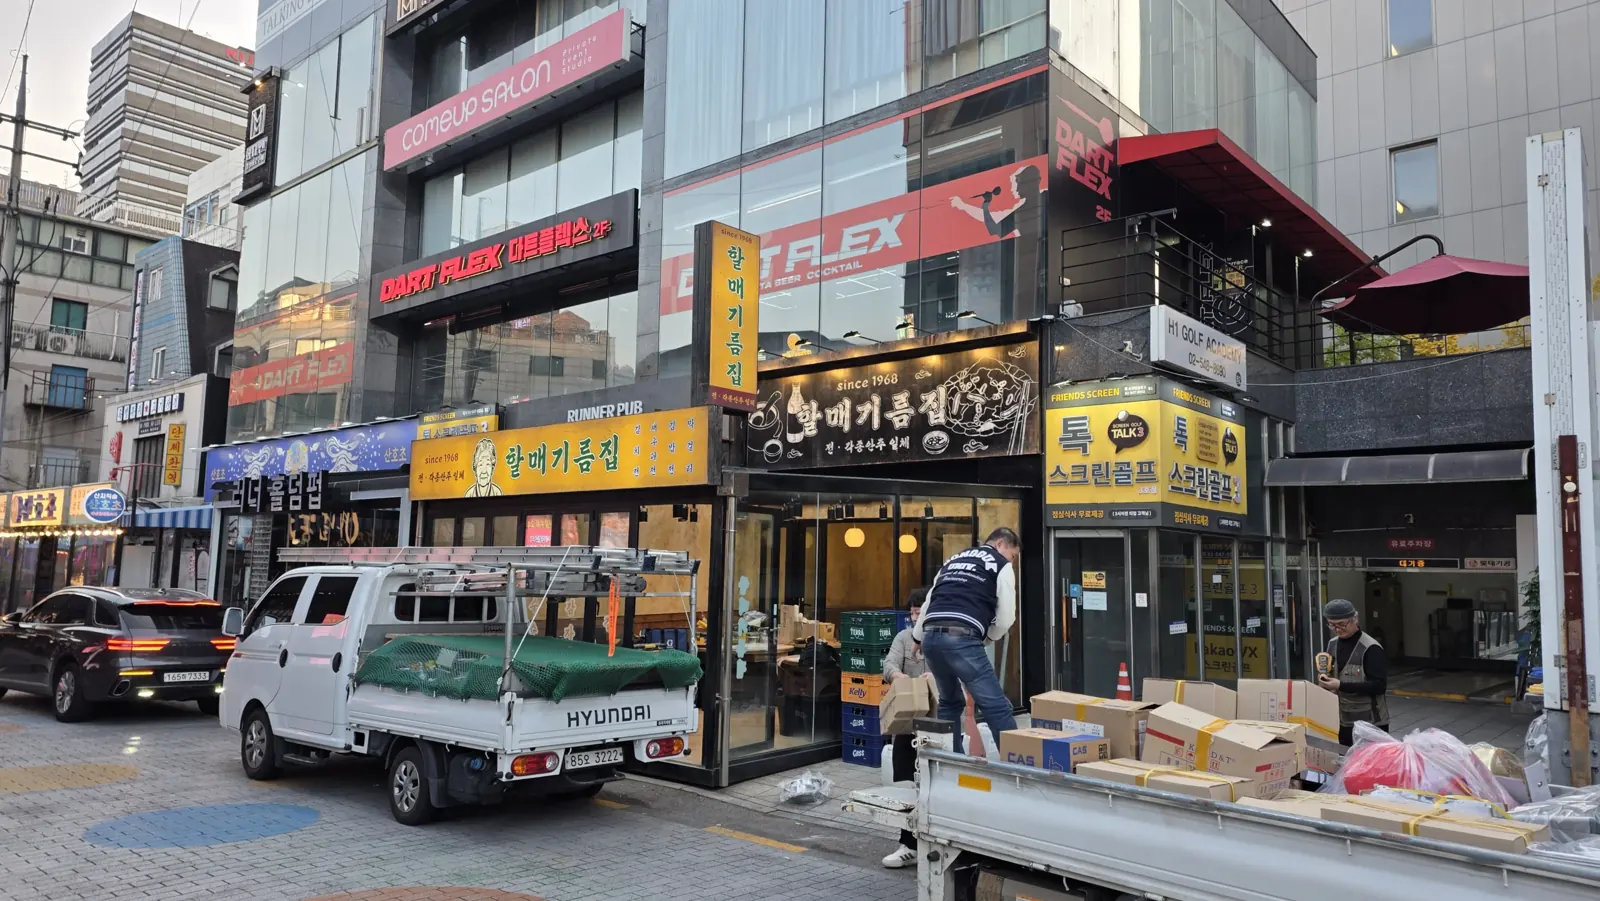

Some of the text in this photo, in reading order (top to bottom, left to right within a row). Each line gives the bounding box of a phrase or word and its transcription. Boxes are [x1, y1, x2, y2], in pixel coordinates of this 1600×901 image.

[562, 35, 597, 57] Private
[562, 47, 588, 66] Event
[561, 55, 592, 75] Studio
[1055, 117, 1115, 174] DART
[1055, 145, 1114, 200] FLEX
[721, 228, 753, 244] since 1968
[784, 212, 907, 273] FLEX
[380, 216, 612, 303] DART FLEX 다트플렉스 2F
[774, 274, 802, 287] BEER
[806, 260, 863, 279] COCKTAIL
[726, 244, 745, 387] 할매기름집
[1168, 318, 1242, 364] H1 GOLF ACADEMY
[837, 373, 899, 391] since 1968
[1051, 391, 1086, 402] FRIENDS
[1086, 388, 1120, 399] SCREEN
[1173, 387, 1211, 408] FRIENDS SCREEN
[616, 400, 643, 415] PUB
[796, 384, 948, 437] 할매기름집
[844, 437, 887, 453] 각종안주
[888, 435, 911, 450] 일체
[1058, 414, 1094, 456] 톡
[1173, 415, 1188, 454] 톡
[425, 452, 459, 465] since 1968
[504, 432, 620, 480] 할매기름집
[1048, 459, 1160, 487] 스크린골프
[1168, 462, 1243, 505] 스크린골프 3
[1052, 509, 1077, 519] 점심식사
[1078, 509, 1105, 519] 무료제공
[1398, 559, 1425, 568] 대기중
[1479, 559, 1511, 568] 롯데기공
[848, 687, 867, 698] Kelly
[567, 705, 651, 728] HYUNDAI
[594, 748, 619, 764] 3222
[1007, 752, 1035, 768] CAS
[1072, 745, 1088, 756] CAS
